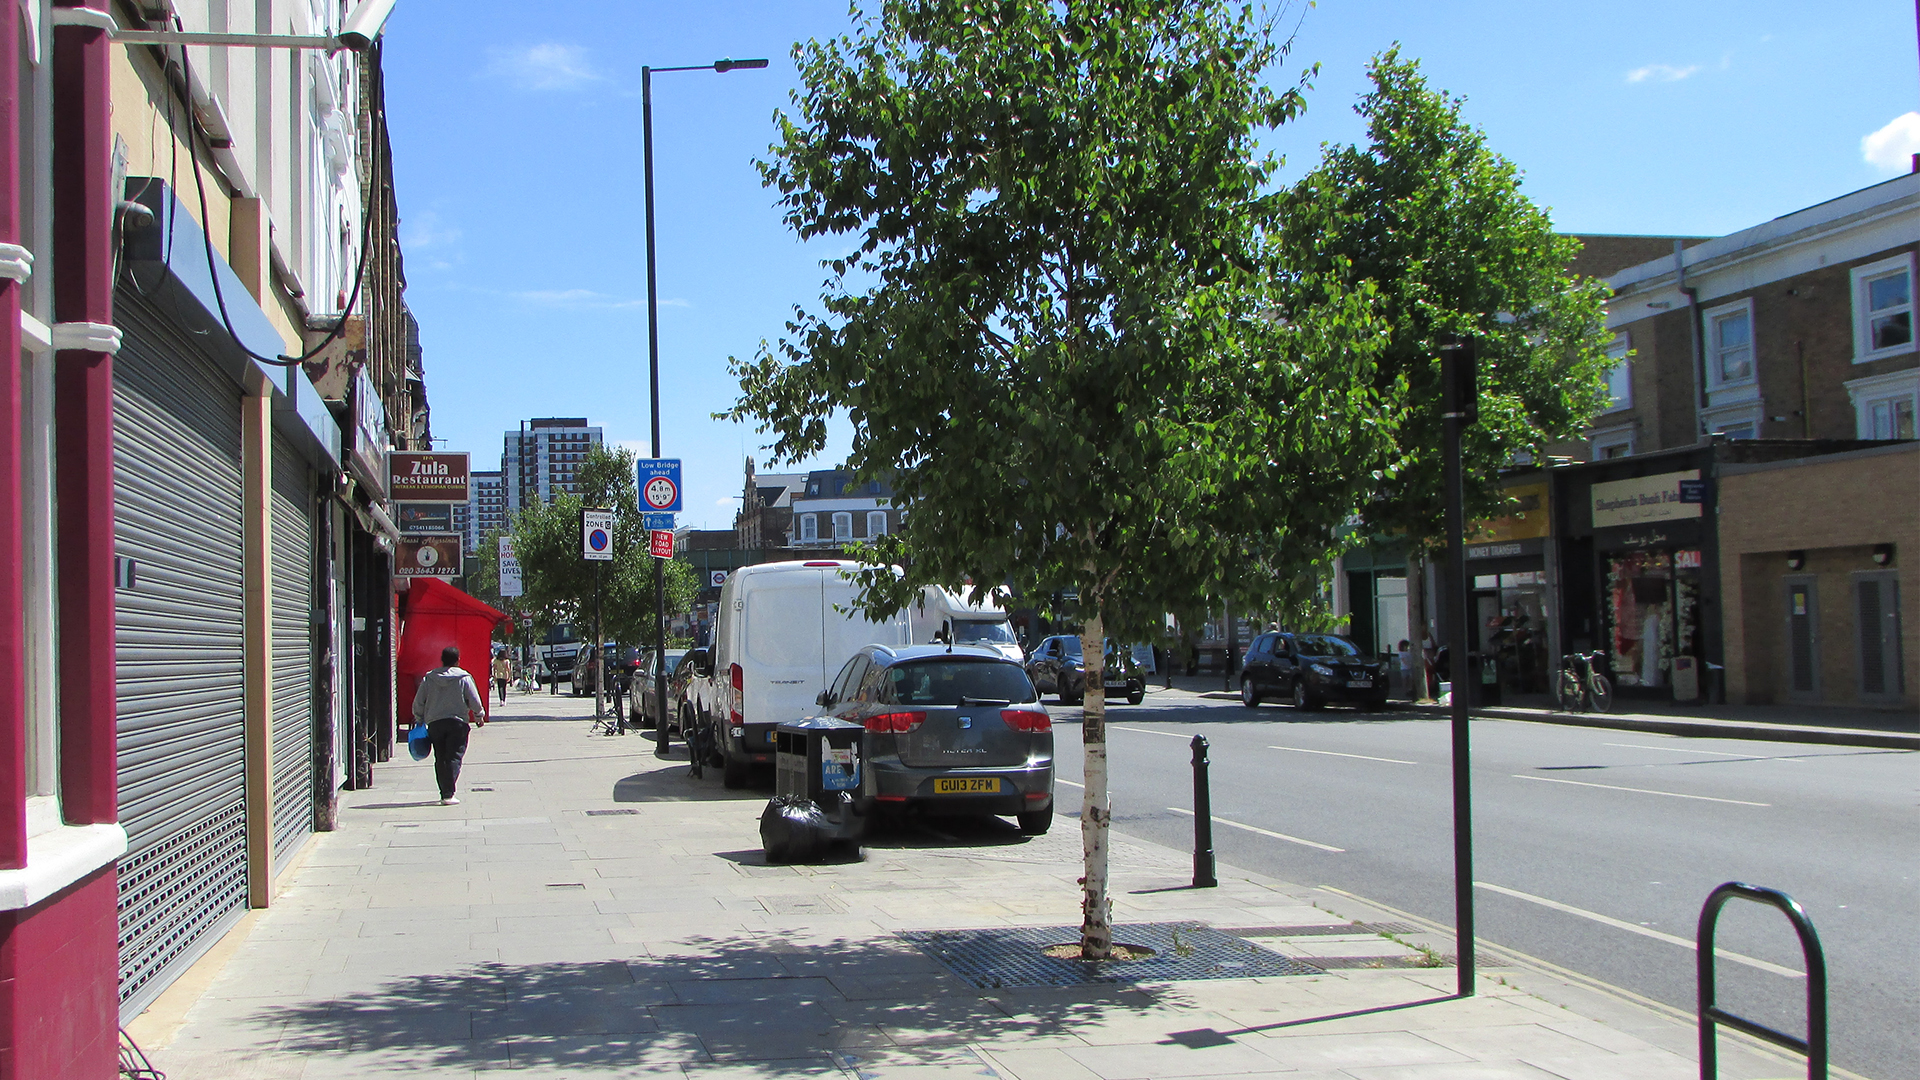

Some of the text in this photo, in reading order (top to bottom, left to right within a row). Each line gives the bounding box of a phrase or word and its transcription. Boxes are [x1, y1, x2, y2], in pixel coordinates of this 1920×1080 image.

[411, 461, 448, 475] Zula
[393, 475, 466, 485] Restaurant
[655, 540, 670, 548] ROAD
[652, 546, 672, 555] LAYOUT
[1469, 544, 1522, 558] MONEY TRANSFER
[1674, 551, 1700, 567] SAL
[941, 780, 993, 791] GU13 ZFM
